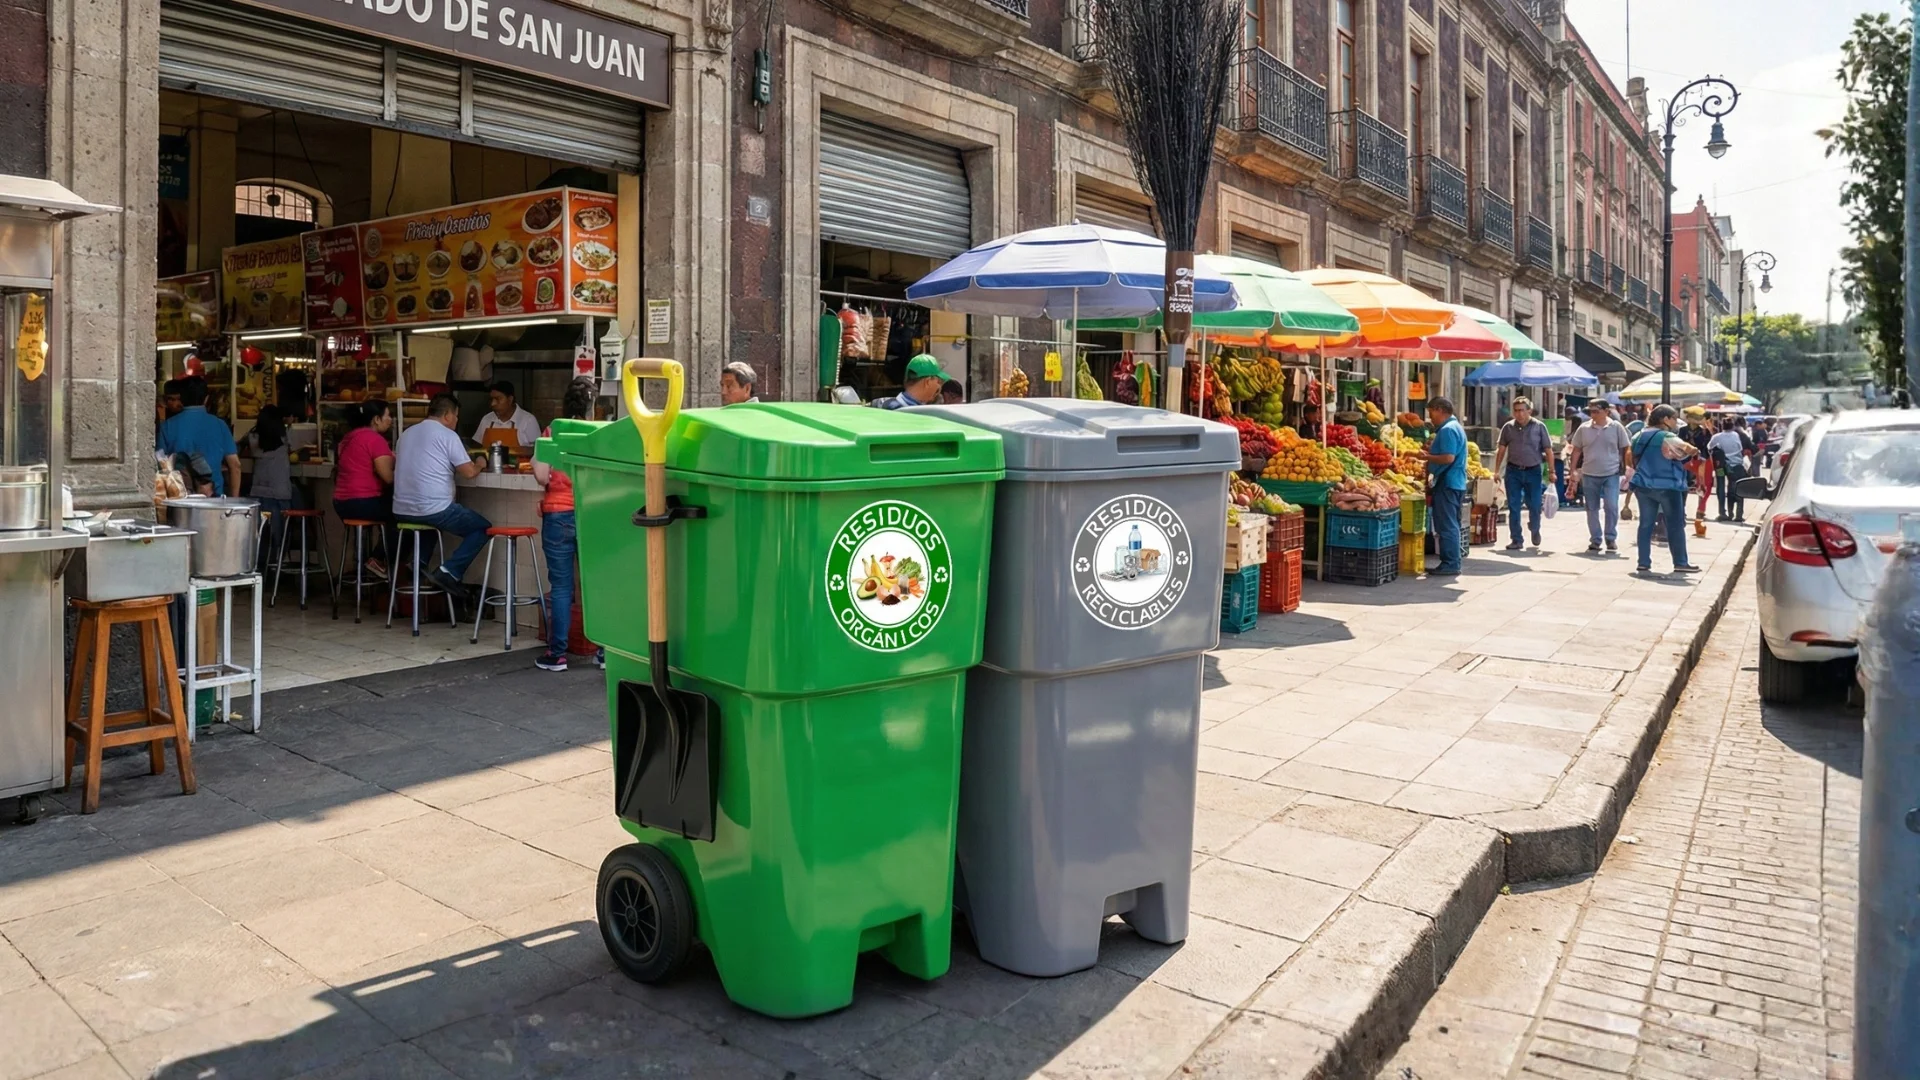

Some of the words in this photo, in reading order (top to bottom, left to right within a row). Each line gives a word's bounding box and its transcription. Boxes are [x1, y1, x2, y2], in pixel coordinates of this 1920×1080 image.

[444, 0, 489, 40] DE
[499, 7, 562, 59] SAN
[569, 28, 645, 81] JUAN
[838, 506, 942, 552] RESIDUOS
[1085, 499, 1182, 538] RESIDUOS
[1082, 577, 1183, 625] RECICLABLES
